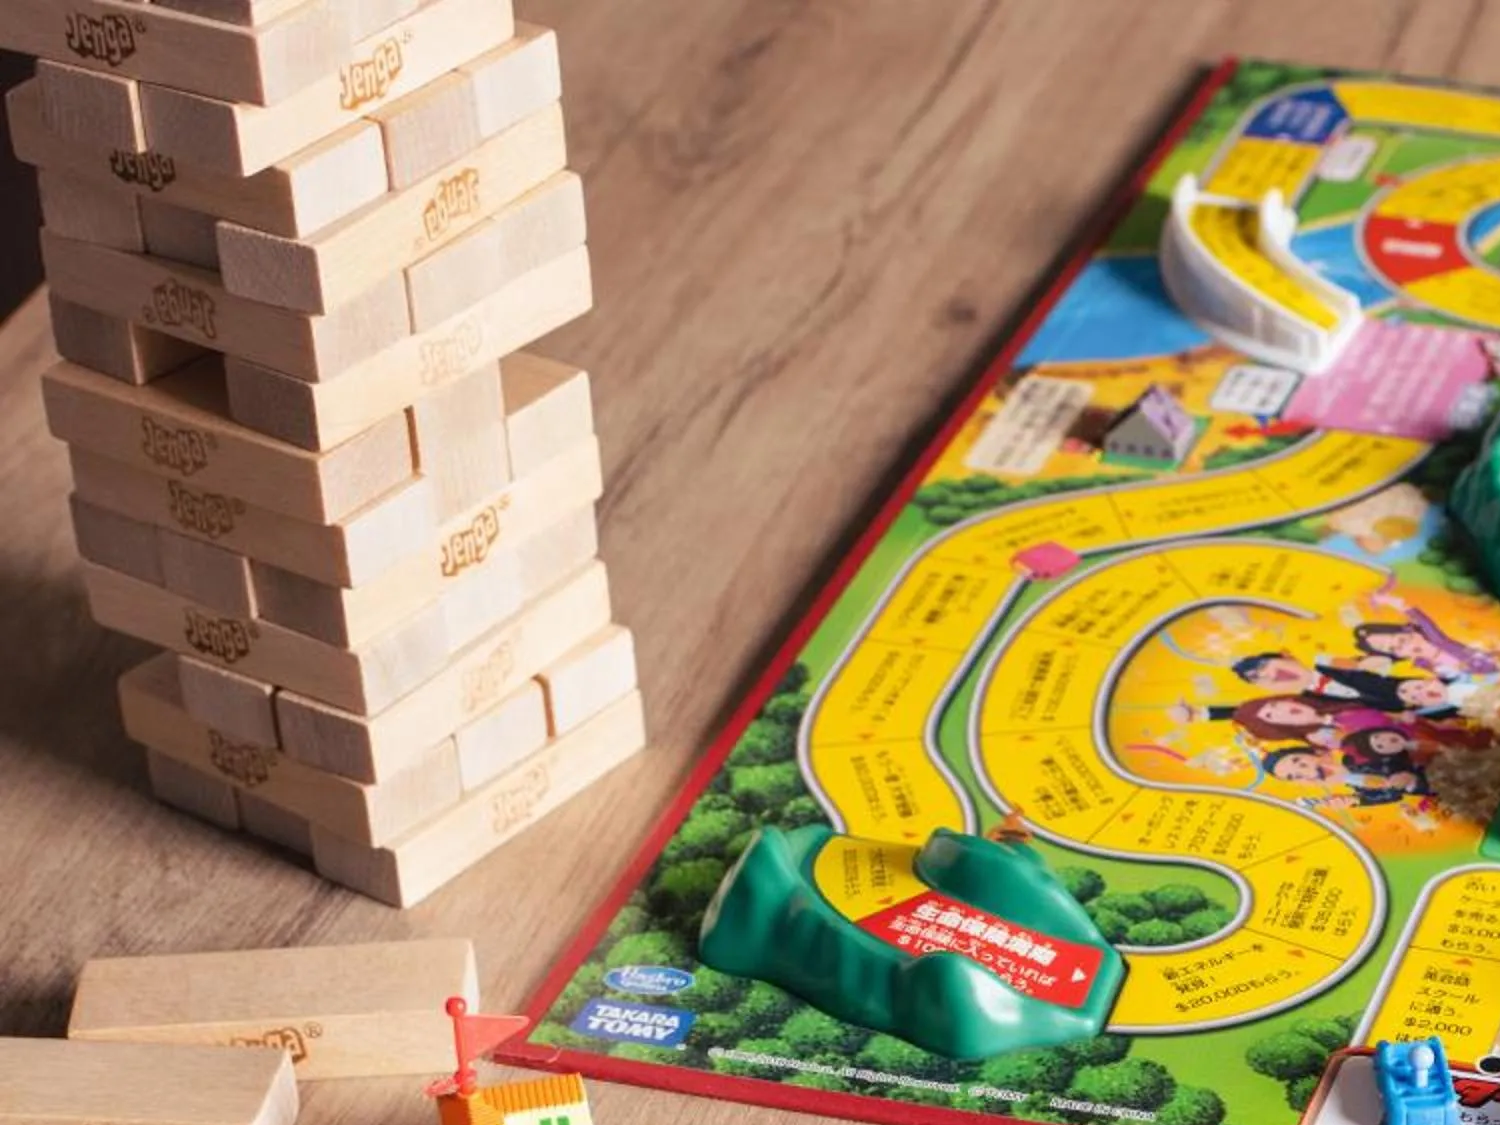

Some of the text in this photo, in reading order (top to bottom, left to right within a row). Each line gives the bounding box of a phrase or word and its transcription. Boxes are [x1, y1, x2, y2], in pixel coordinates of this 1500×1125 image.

[66, 15, 135, 65] Jenga
[340, 37, 402, 108] Jenga
[424, 168, 481, 240] Jenga
[150, 278, 218, 337] Jenga
[141, 418, 209, 472] Jenga
[168, 480, 234, 537] Jenga
[440, 505, 500, 577] Jenga
[185, 612, 249, 660] Jenga
[587, 1016, 676, 1041] TOMY
[594, 1004, 681, 1029] TAKARA
